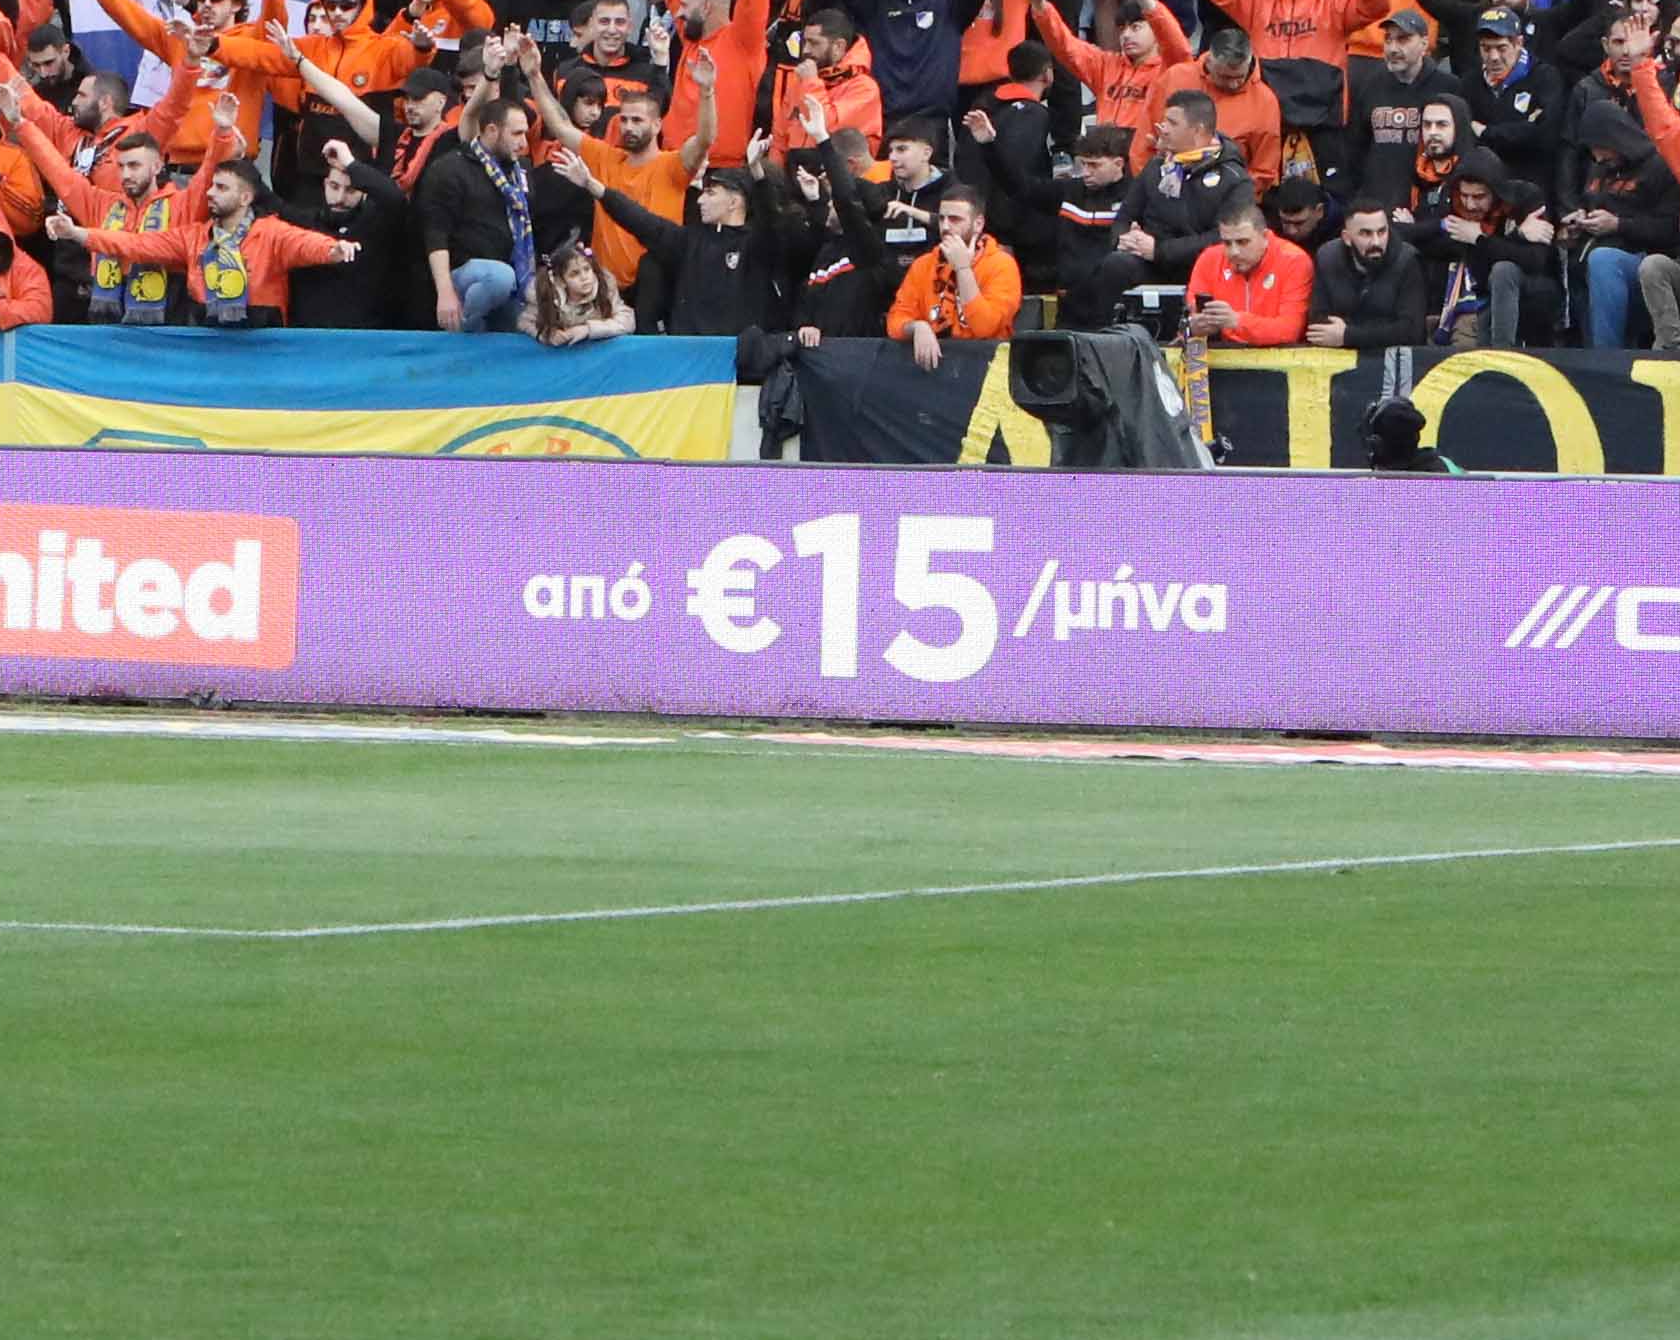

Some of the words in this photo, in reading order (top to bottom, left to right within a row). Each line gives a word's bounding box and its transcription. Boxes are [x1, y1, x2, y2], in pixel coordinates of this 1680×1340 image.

[522, 561, 652, 626] από
[685, 511, 1000, 683] €15
[1013, 559, 1230, 643] /μήνα
